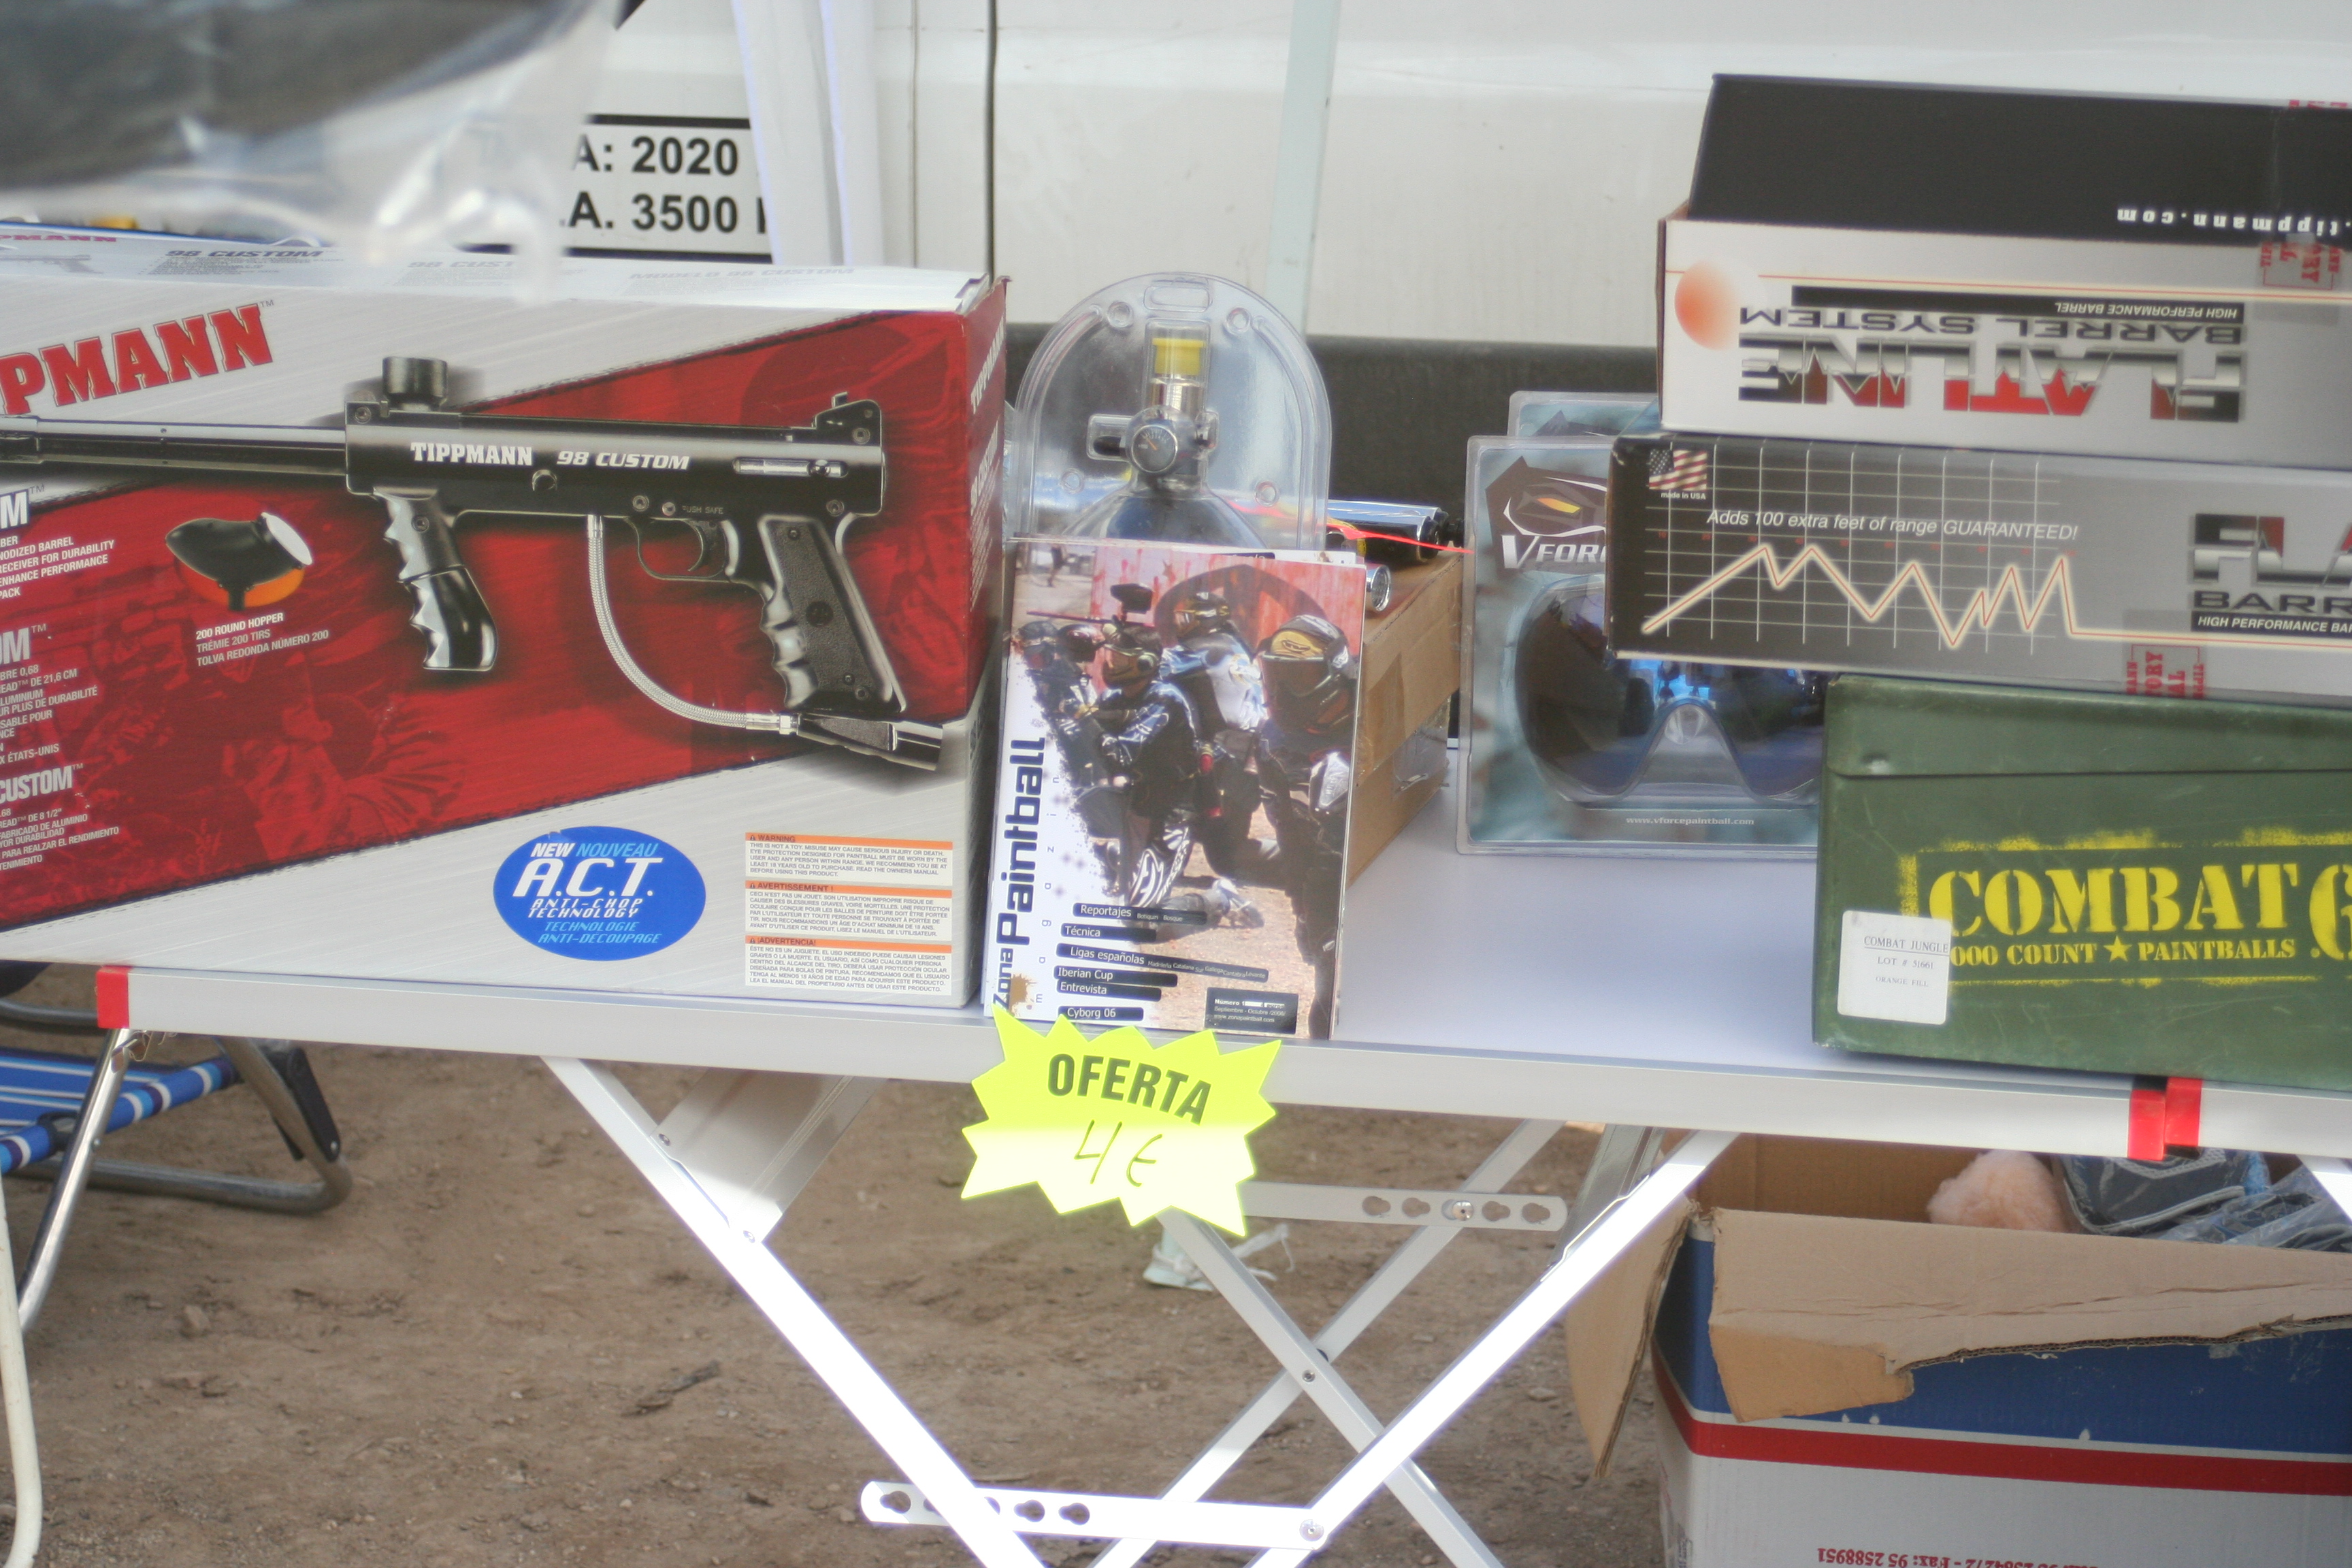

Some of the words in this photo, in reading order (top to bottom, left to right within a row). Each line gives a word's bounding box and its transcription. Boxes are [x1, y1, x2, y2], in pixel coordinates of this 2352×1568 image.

[632, 136, 738, 176] 2020
[632, 193, 738, 233] 3500
[2055, 302, 2104, 314] BARREL
[2107, 304, 2202, 318] PERFORMANCE
[2206, 308, 2238, 319] HIGH
[1740, 308, 1975, 334] SYSTEM
[1995, 318, 2241, 344] BARREL
[1738, 333, 2242, 423] FLATLINE
[410, 442, 533, 466] TIPPMANN
[557, 451, 589, 467] 98
[595, 453, 690, 470] CUSTOM
[1707, 510, 1748, 525] Adds
[1755, 511, 1784, 526] 100
[1788, 513, 1829, 529] extra
[1833, 514, 1865, 530] feet
[1869, 516, 1887, 531] of
[1889, 520, 1937, 537] range
[1943, 520, 2078, 540] GUARANTEED!
[38, 536, 74, 552] BARREL
[42, 552, 59, 564] FOR
[62, 540, 114, 559] DURABILITY
[41, 554, 108, 577] PERFORMANCE
[196, 628, 212, 640] 200
[214, 621, 246, 636] ROUND
[248, 612, 284, 629] HOPPER
[2198, 617, 2229, 627] HIGH
[2232, 618, 2328, 632] PERFORMANCE
[197, 637, 230, 653] TRÉMIE
[231, 634, 248, 645] 200
[250, 629, 270, 642] TIRS
[197, 653, 225, 666] TOLVA
[227, 642, 270, 661] REDONDA
[272, 634, 310, 650] NÚMERO
[312, 630, 329, 642] 200
[20, 664, 39, 676] 0,68
[31, 676, 42, 687] DE
[44, 672, 61, 684] 21,6
[63, 668, 78, 679] CM
[12, 701, 33, 714] PLUS
[35, 698, 46, 708] DE
[48, 685, 98, 706] DURABILITÉ
[29, 709, 52, 723] POUR
[8, 743, 60, 763] ÉTATS-UNIS
[28, 813, 39, 823] DE
[39, 812, 45, 820] 8
[40, 822, 50, 831] DE
[52, 814, 88, 828] ALUMINIO
[1626, 817, 1754, 826] www.vforcepaintball.com
[2, 848, 22, 859] PARA
[23, 840, 56, 854] REALZAR
[58, 838, 67, 847] EL
[69, 826, 119, 845] RENDIMIENTO
[15, 827, 65, 845] DURABILIDAD
[996, 737, 1046, 946] Paintball
[530, 843, 576, 858] NEW
[576, 843, 659, 858] NOUVEAU
[512, 858, 664, 897] A.C.T.
[757, 883, 829, 892] AVERTISSEMENT
[532, 898, 644, 909] ANTI-CHOP
[1929, 864, 2298, 936] COMBAT
[527, 908, 639, 918] TECHNOLOGY
[1081, 904, 1132, 918] Reportajes
[544, 921, 640, 932] TECHNOLOGIE
[1064, 926, 1100, 938] Técnica
[1864, 936, 1906, 949] COMBAT
[1910, 941, 1949, 953] JUNGLE
[2006, 943, 2097, 966] COUNT
[2138, 938, 2296, 962] PAINTBALLS
[1070, 946, 1095, 960] Ligas
[1097, 949, 1145, 965] españolas
[1878, 956, 1897, 966] LOT
[993, 947, 1013, 1010] Zona
[1058, 967, 1092, 979] Iberian
[1094, 969, 1113, 983] Cup
[1875, 976, 1908, 985] ORANGE
[1060, 981, 1107, 995] Entrevista
[1067, 1007, 1100, 1019] Cyborg
[1104, 1008, 1116, 1018] 06
[1047, 1054, 1211, 1126] OFERTA
[1818, 1548, 1884, 1567] 2588951
[1889, 1554, 1908, 1568] 95
